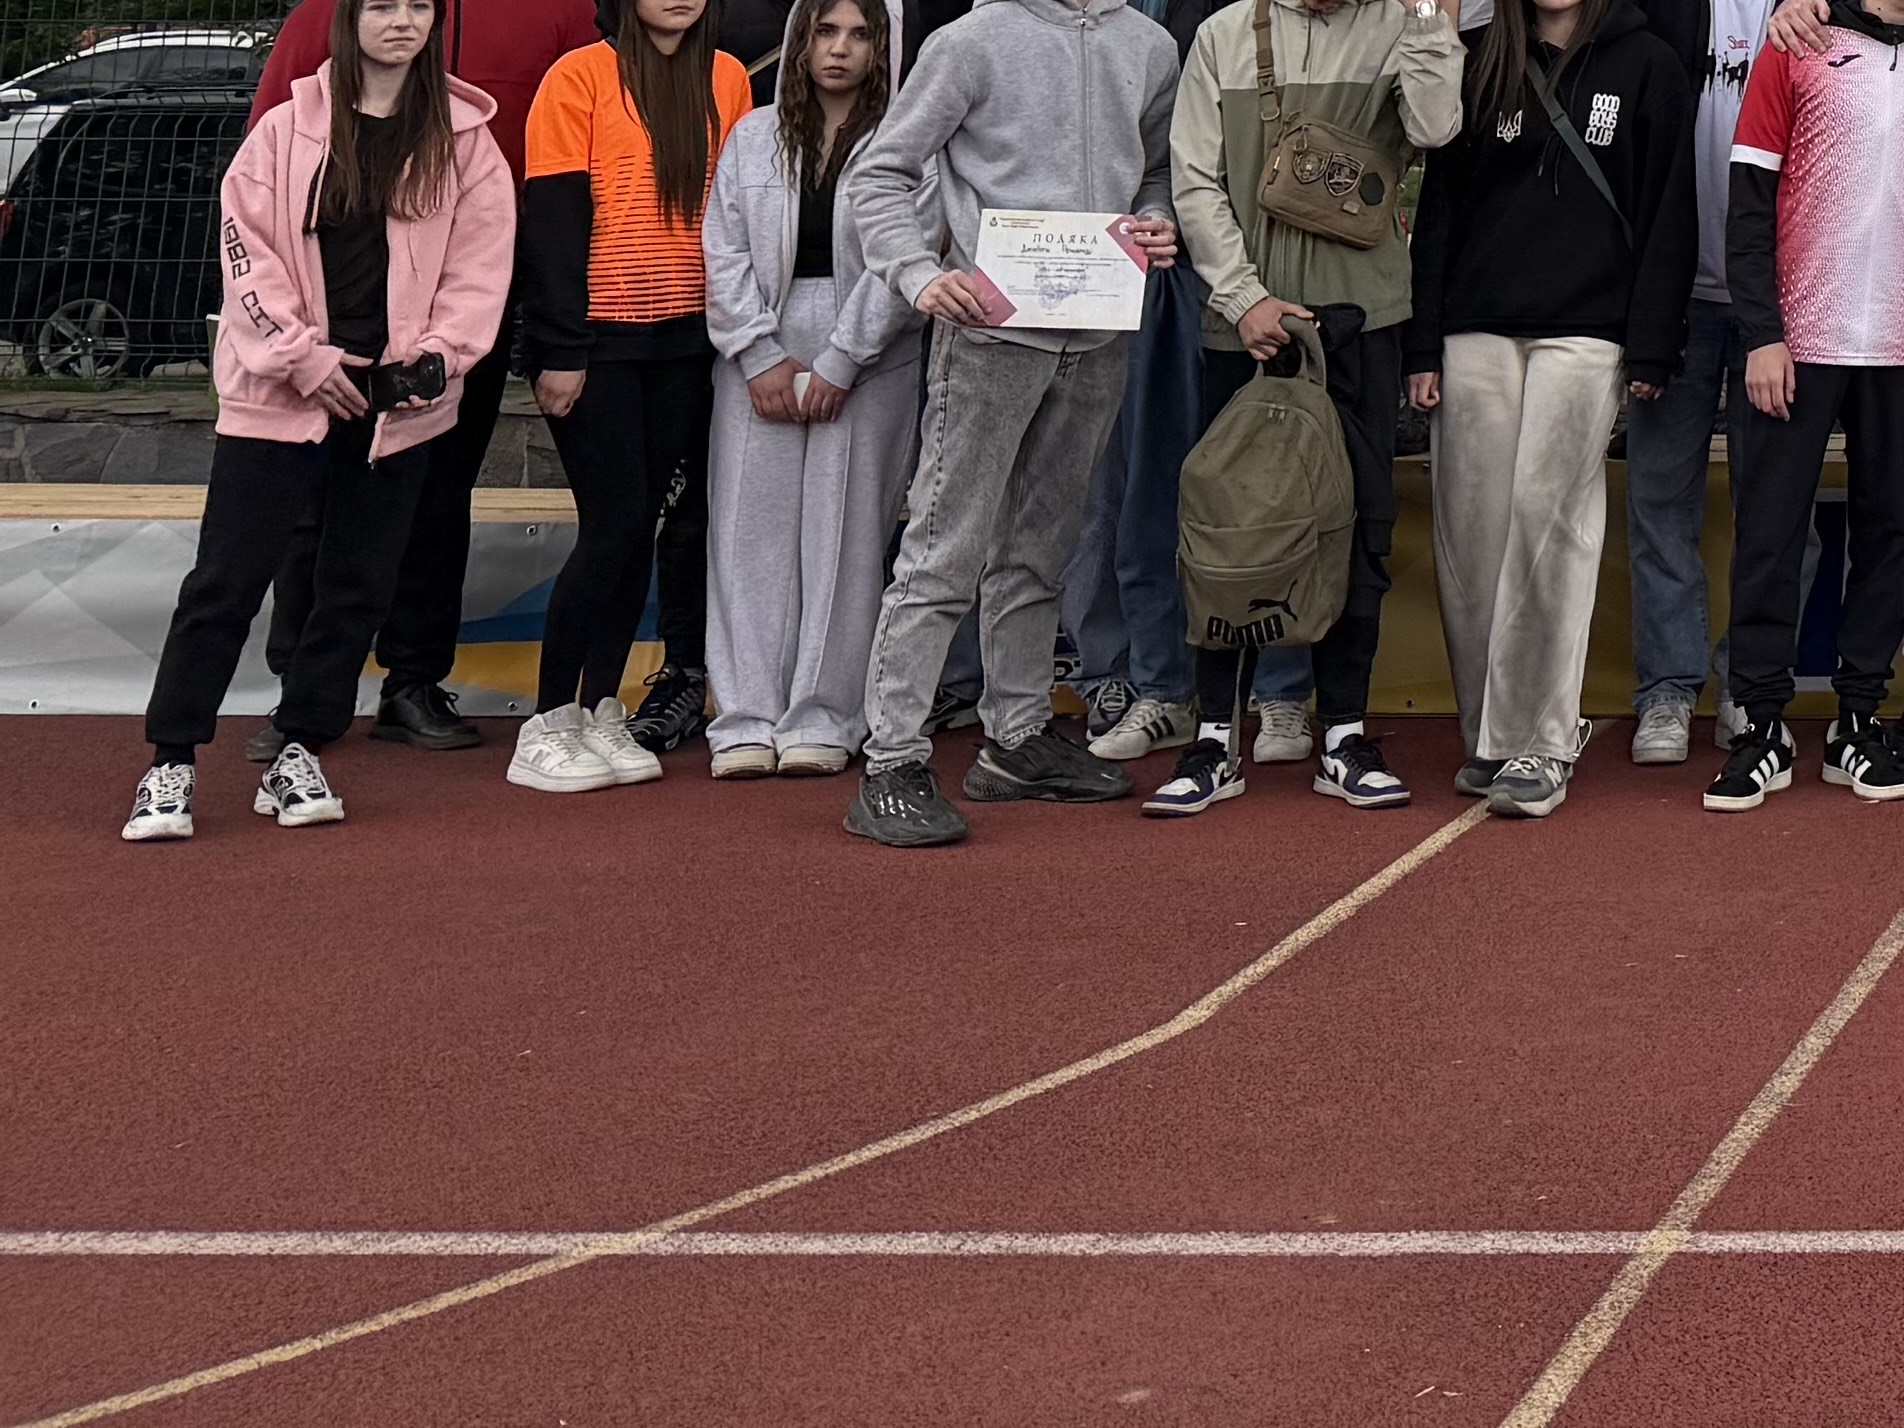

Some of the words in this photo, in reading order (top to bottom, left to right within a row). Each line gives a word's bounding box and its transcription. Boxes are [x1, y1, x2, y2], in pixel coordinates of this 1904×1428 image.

[223, 216, 251, 281] 1982
[1033, 233, 1098, 245] ПОДЯКА
[240, 290, 284, 339] CIT
[1206, 613, 1285, 650] PUMA
